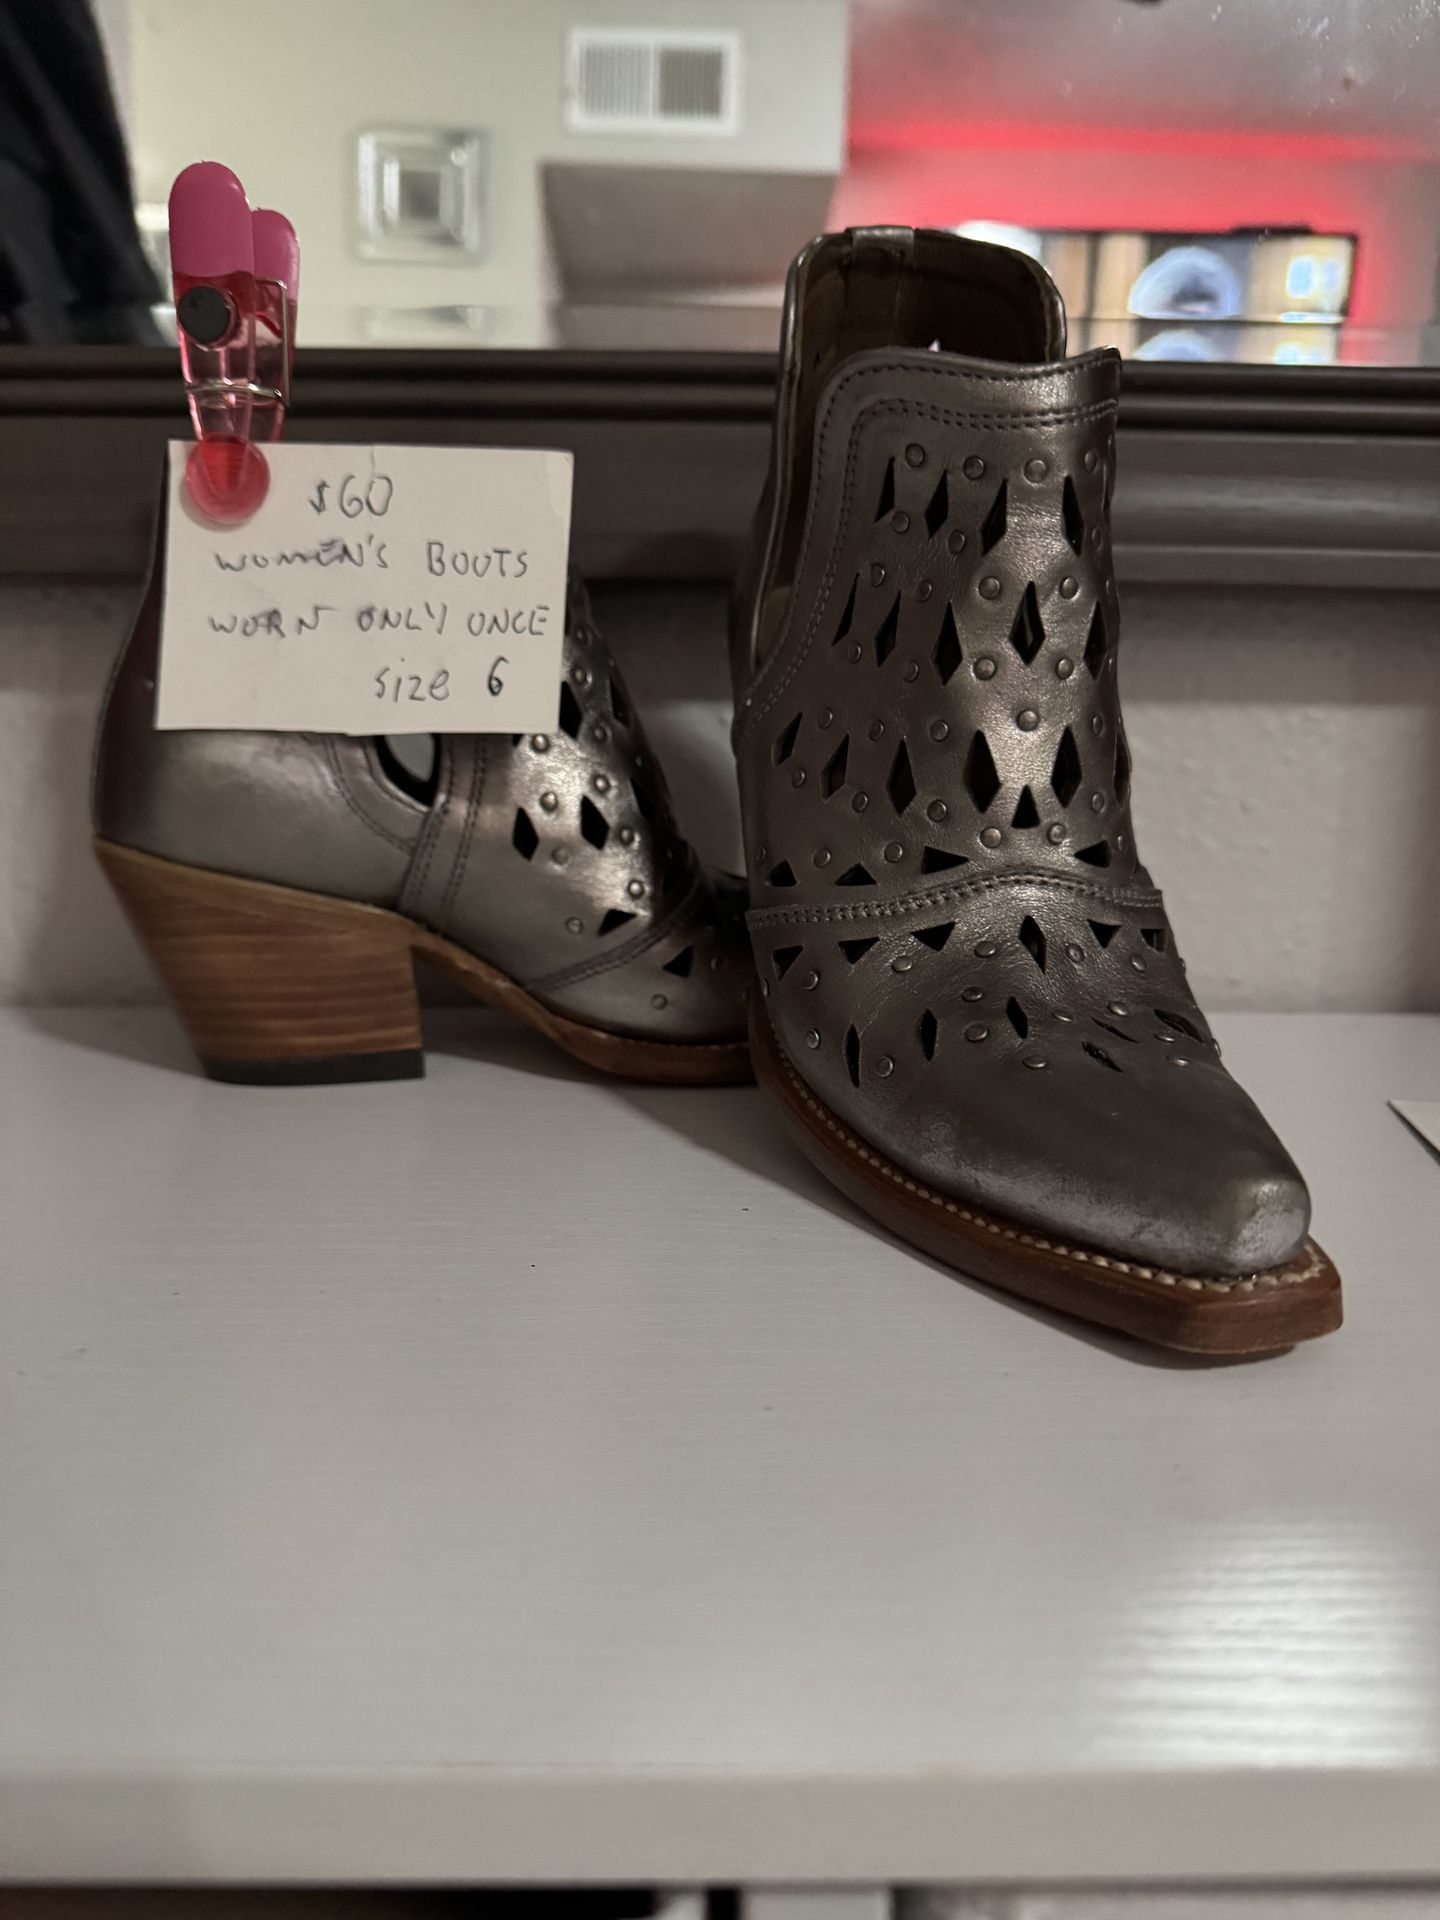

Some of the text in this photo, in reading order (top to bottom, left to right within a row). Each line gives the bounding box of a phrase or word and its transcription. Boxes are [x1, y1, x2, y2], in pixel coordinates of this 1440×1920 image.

[309, 474, 393, 518] $60
[427, 541, 528, 577] BOOTS
[357, 602, 446, 634] ONLY
[467, 606, 549, 636] ONCE
[487, 656, 509, 696] 6
